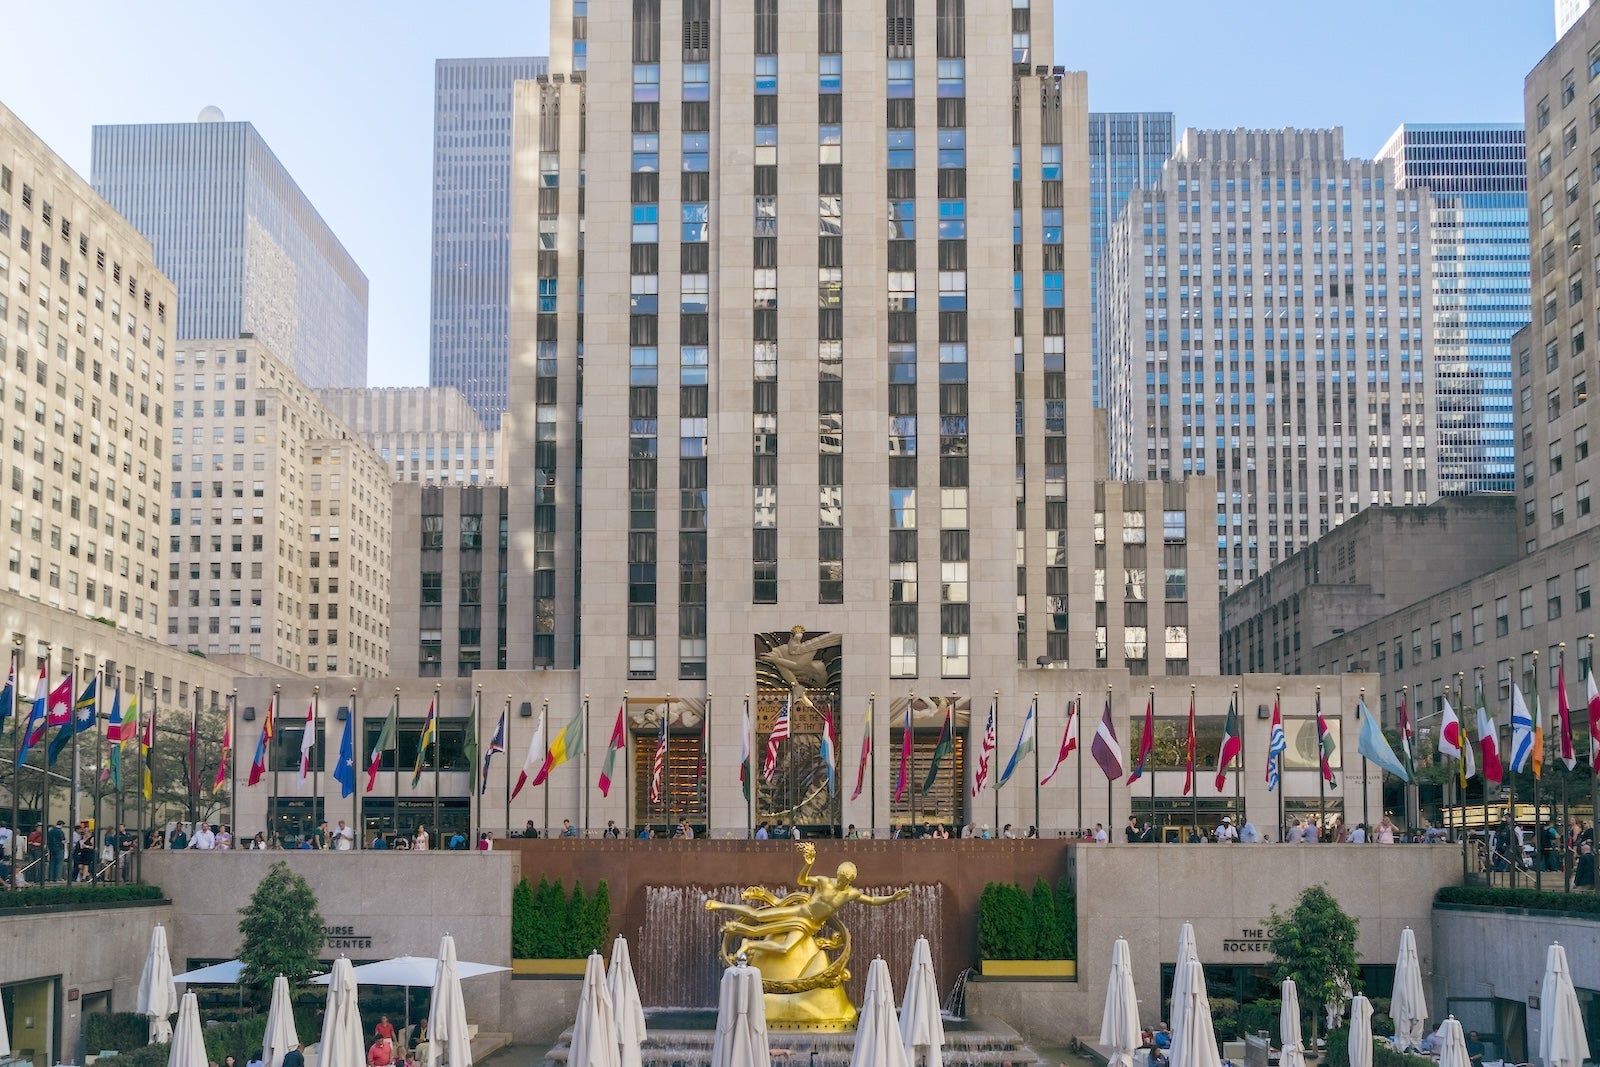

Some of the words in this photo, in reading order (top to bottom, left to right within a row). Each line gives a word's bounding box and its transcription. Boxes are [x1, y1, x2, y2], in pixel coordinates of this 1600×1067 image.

[320, 926, 355, 935] OURSE
[1243, 929, 1263, 938] THE
[328, 940, 372, 949] CENTER
[1223, 943, 1270, 953] ROCKEF
